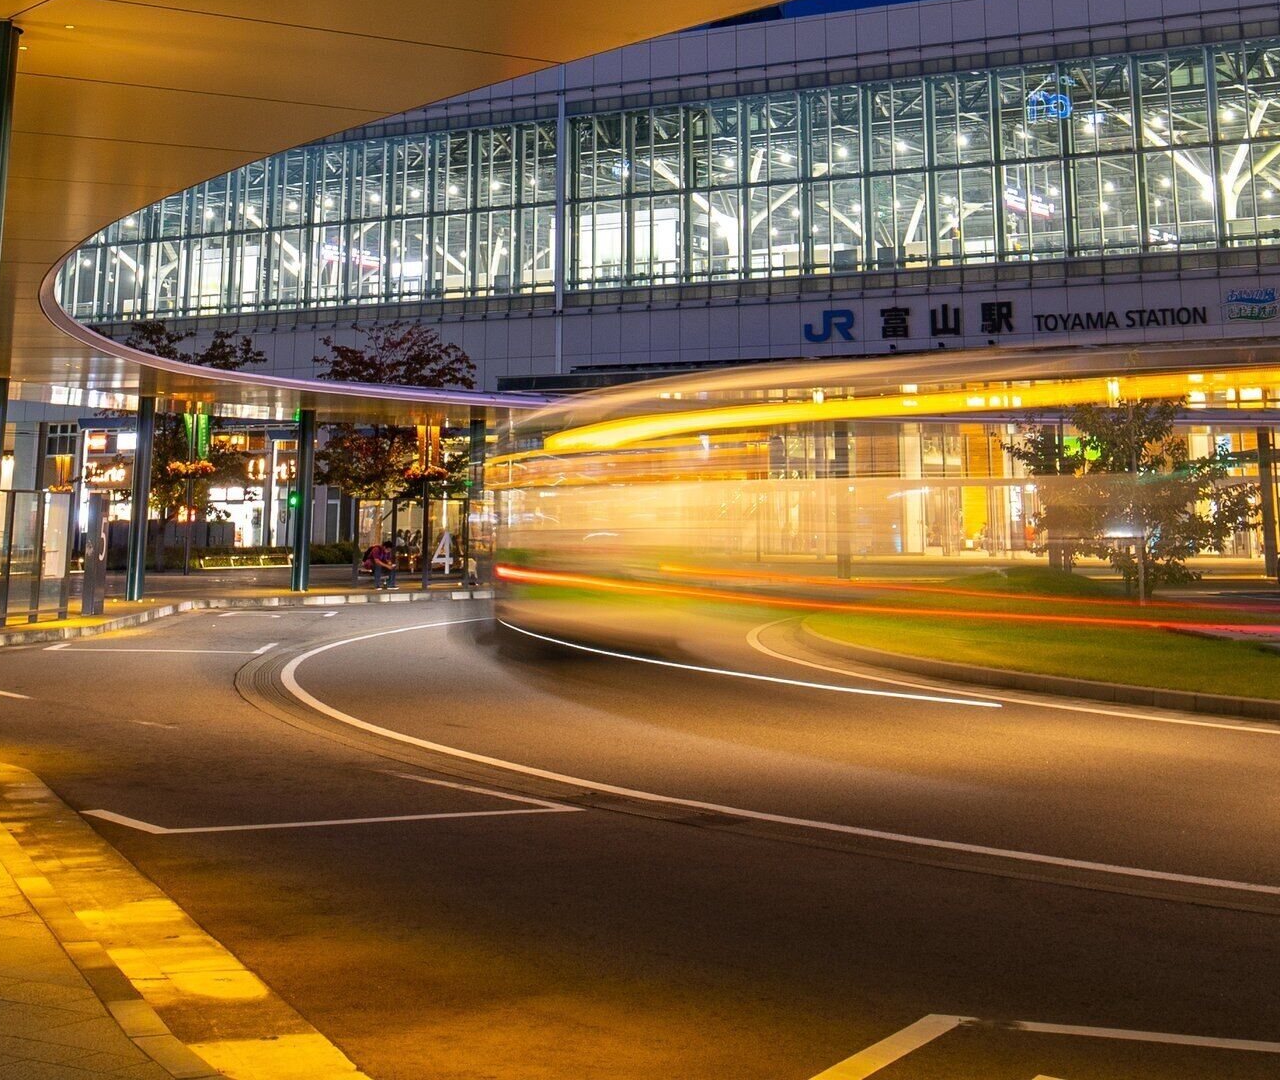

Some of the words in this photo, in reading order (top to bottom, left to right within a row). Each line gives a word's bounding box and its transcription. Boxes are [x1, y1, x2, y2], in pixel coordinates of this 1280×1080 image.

[804, 309, 855, 342] JR
[880, 301, 1014, 339] 富山駅
[1034, 311, 1119, 332] TOYAMA
[1125, 306, 1208, 328] STATION
[99, 517, 108, 561] 5
[431, 531, 454, 574] 4
